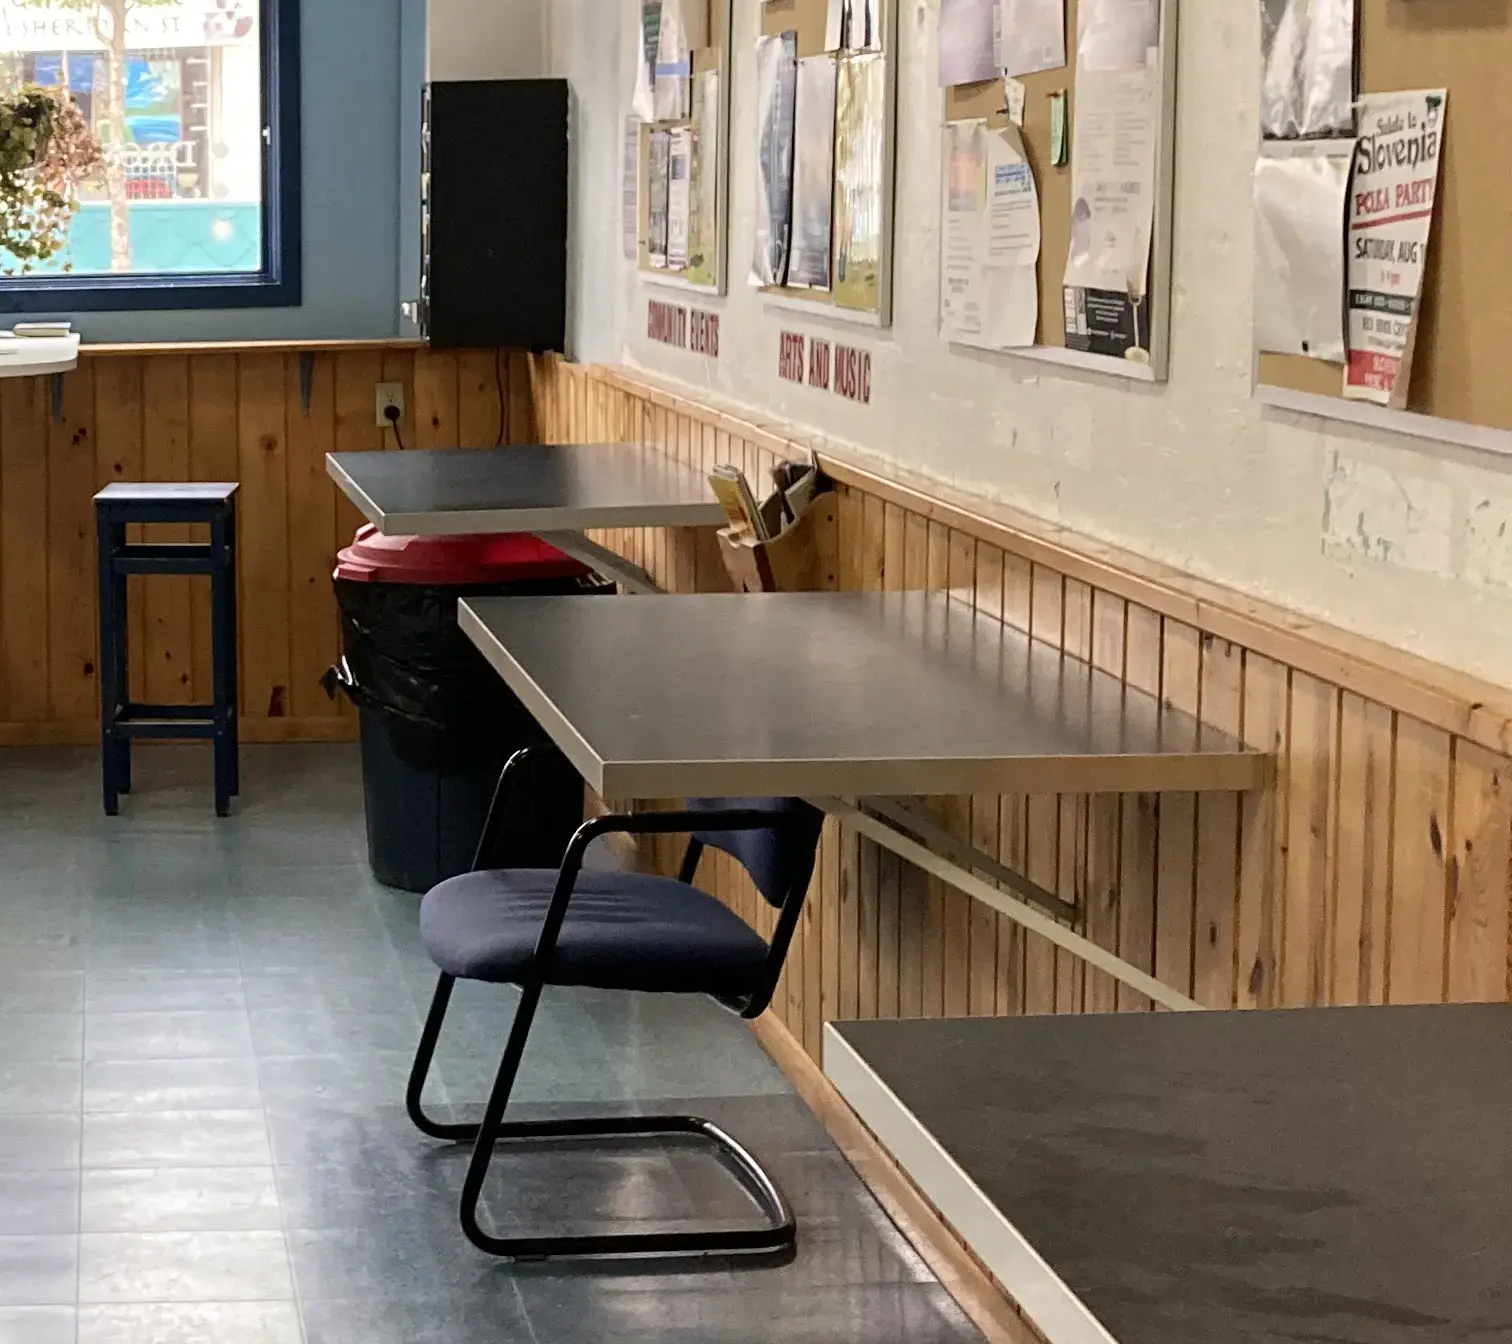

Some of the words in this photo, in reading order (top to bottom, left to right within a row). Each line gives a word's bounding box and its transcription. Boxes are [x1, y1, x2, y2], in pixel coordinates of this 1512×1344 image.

[1355, 121, 1438, 175] Slovenia
[690, 309, 720, 357] EVENTS
[778, 330, 805, 384] ARTS
[808, 337, 830, 390] AND
[833, 343, 872, 407] MUSIC
